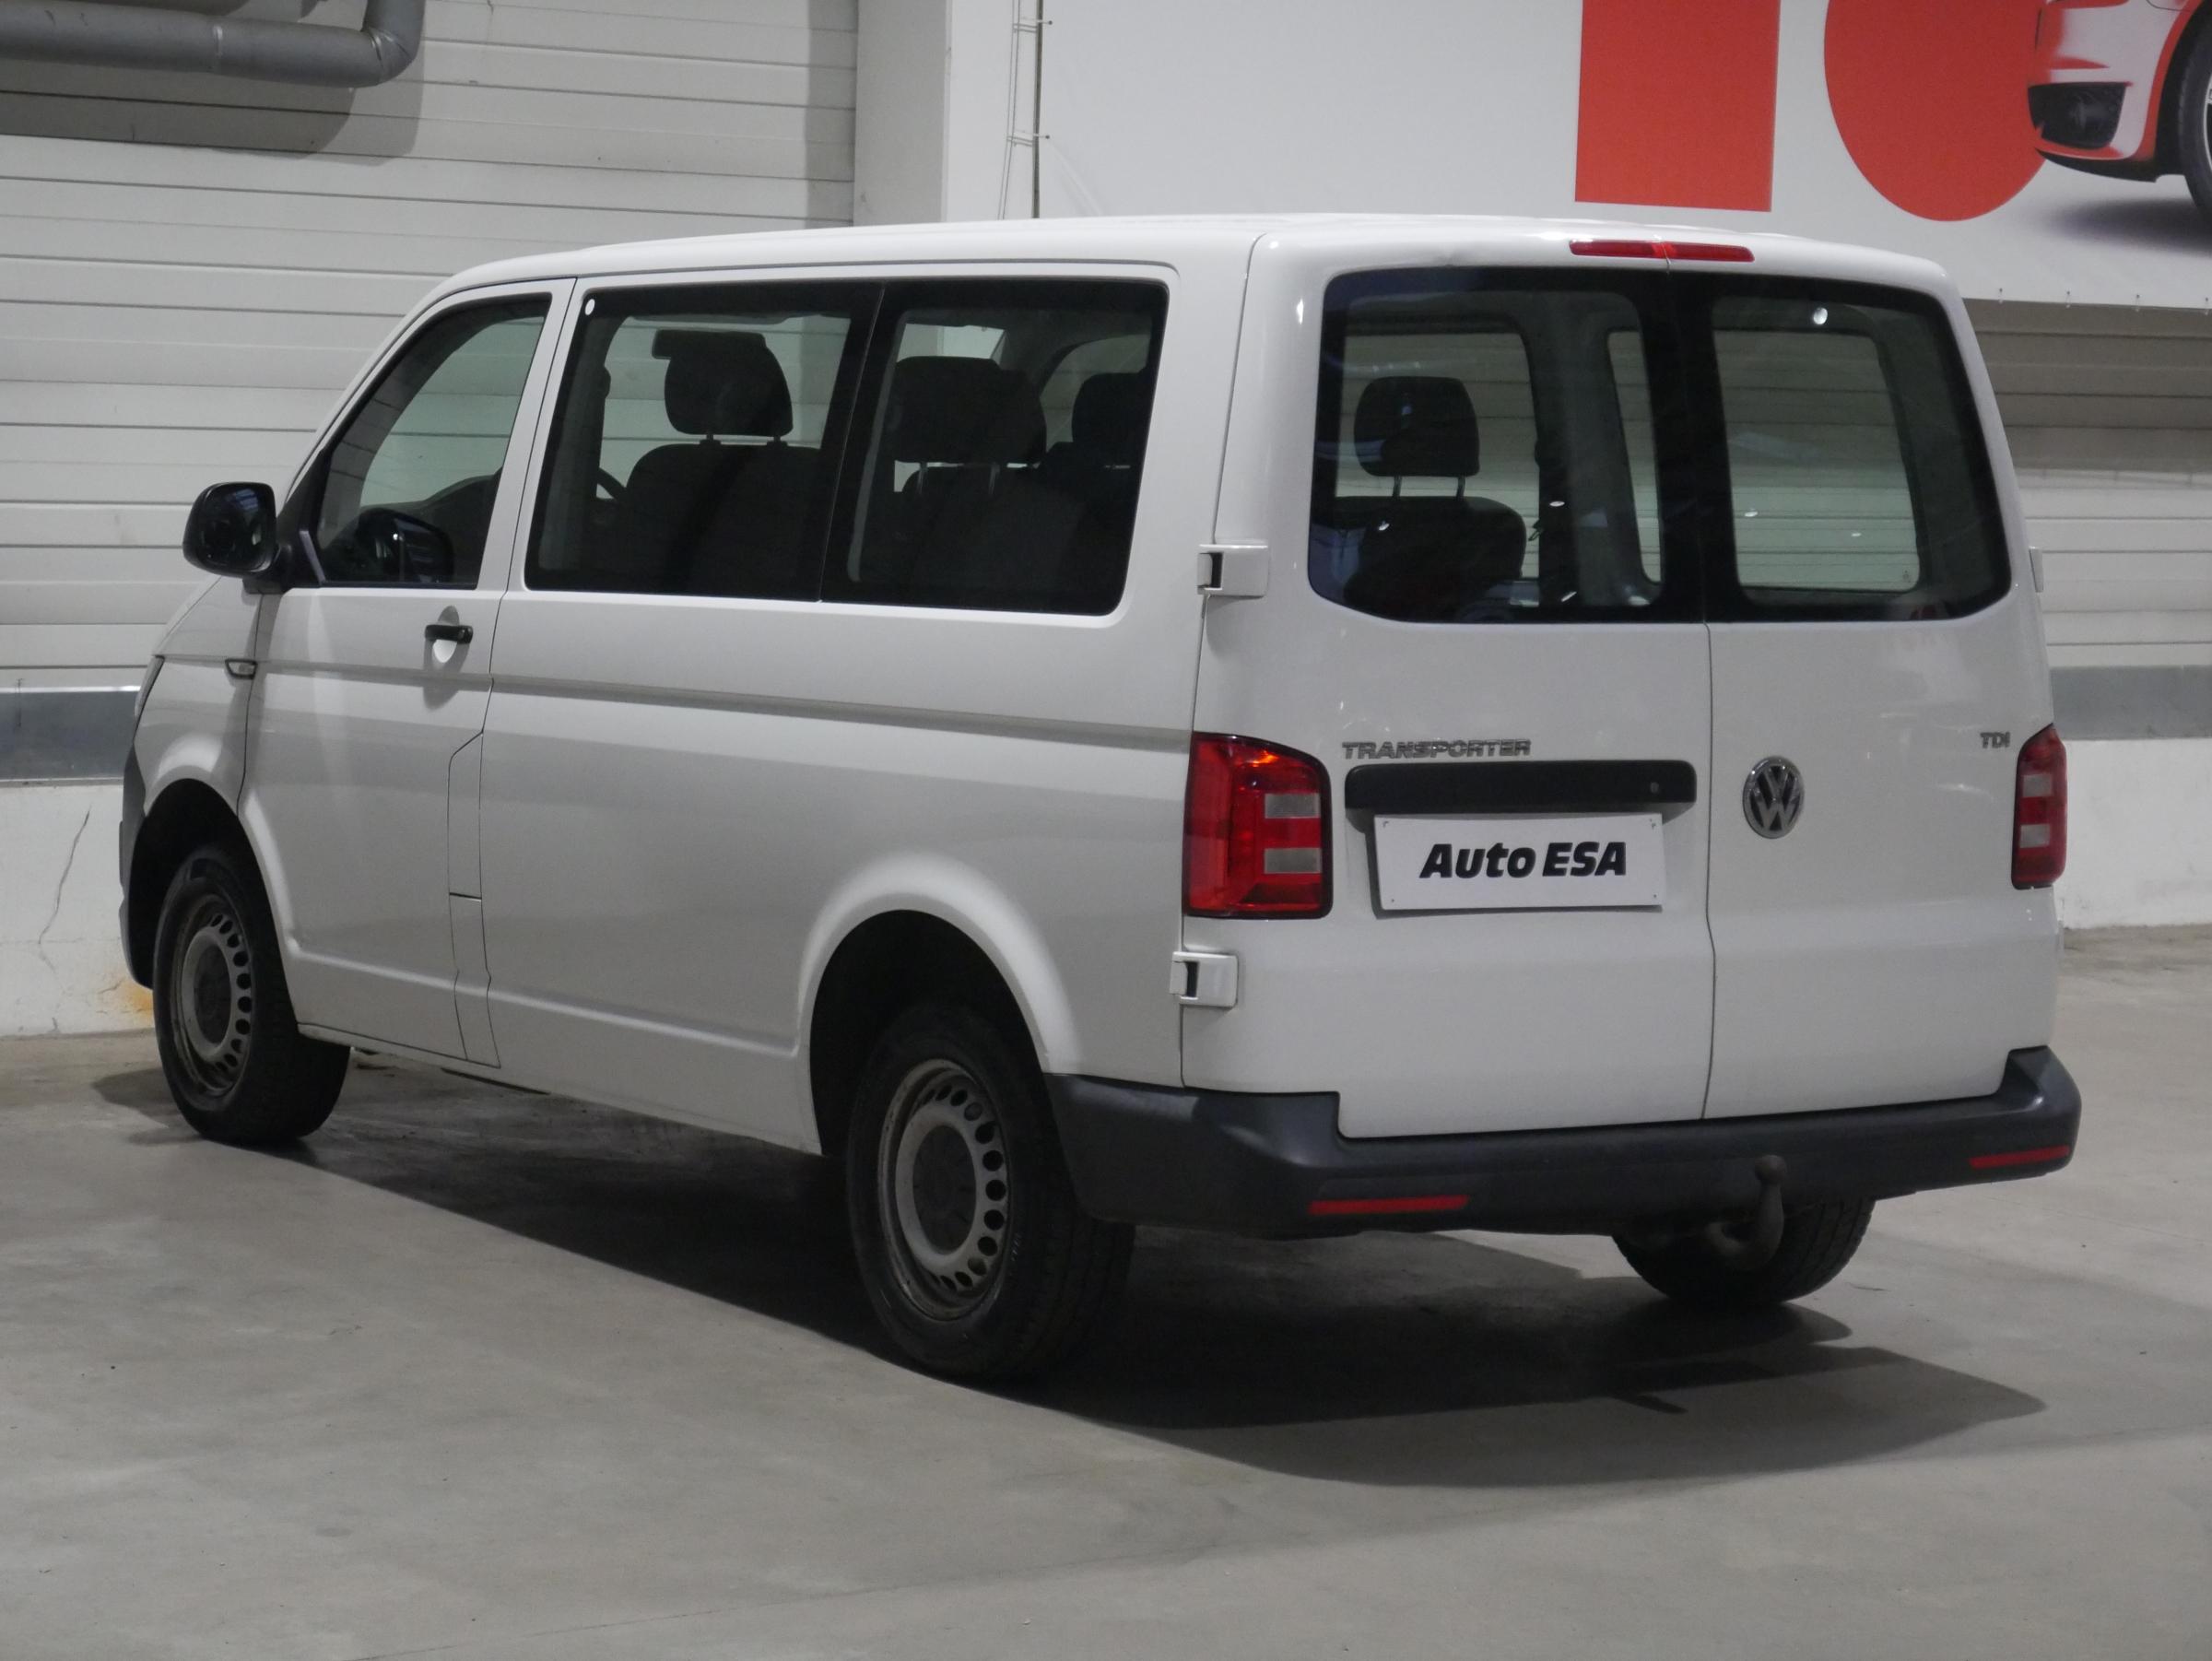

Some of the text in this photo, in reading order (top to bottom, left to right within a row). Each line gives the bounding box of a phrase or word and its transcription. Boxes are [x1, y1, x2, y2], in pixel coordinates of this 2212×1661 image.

[1342, 739, 1532, 760] TRANSPORTER
[1980, 732, 2010, 748] TDI
[1745, 759, 1803, 835] VW
[1418, 841, 1627, 878] Auto ESA
